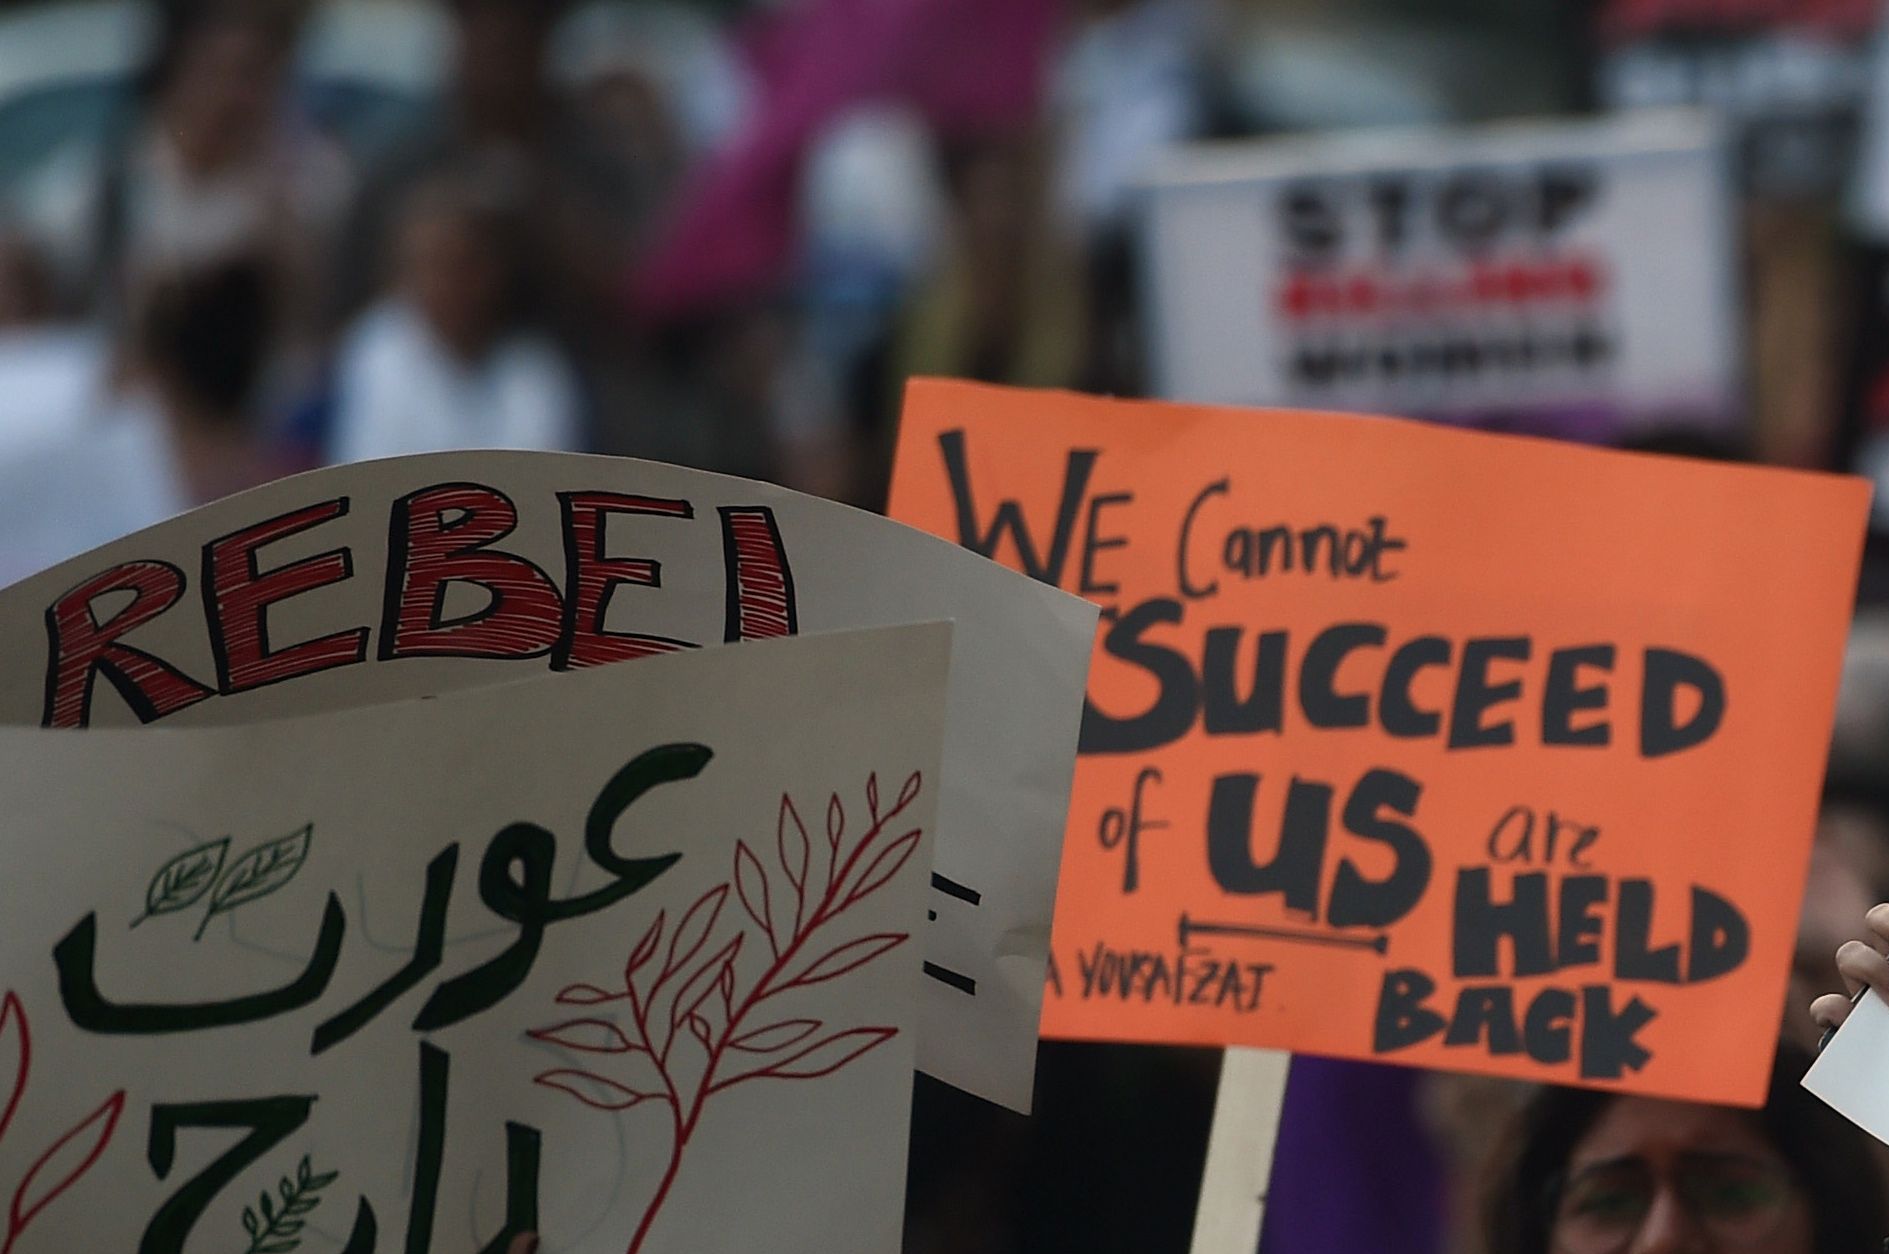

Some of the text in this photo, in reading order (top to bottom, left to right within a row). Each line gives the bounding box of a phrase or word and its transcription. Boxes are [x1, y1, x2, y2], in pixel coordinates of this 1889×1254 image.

[1280, 165, 1600, 250] STOP
[937, 429, 1406, 599] WE Cannot
[1078, 598, 1728, 758] SUCCEED
[1098, 768, 1602, 928] of US are
[1453, 868, 1751, 984] HELD
[1373, 969, 1660, 1081] BACK
